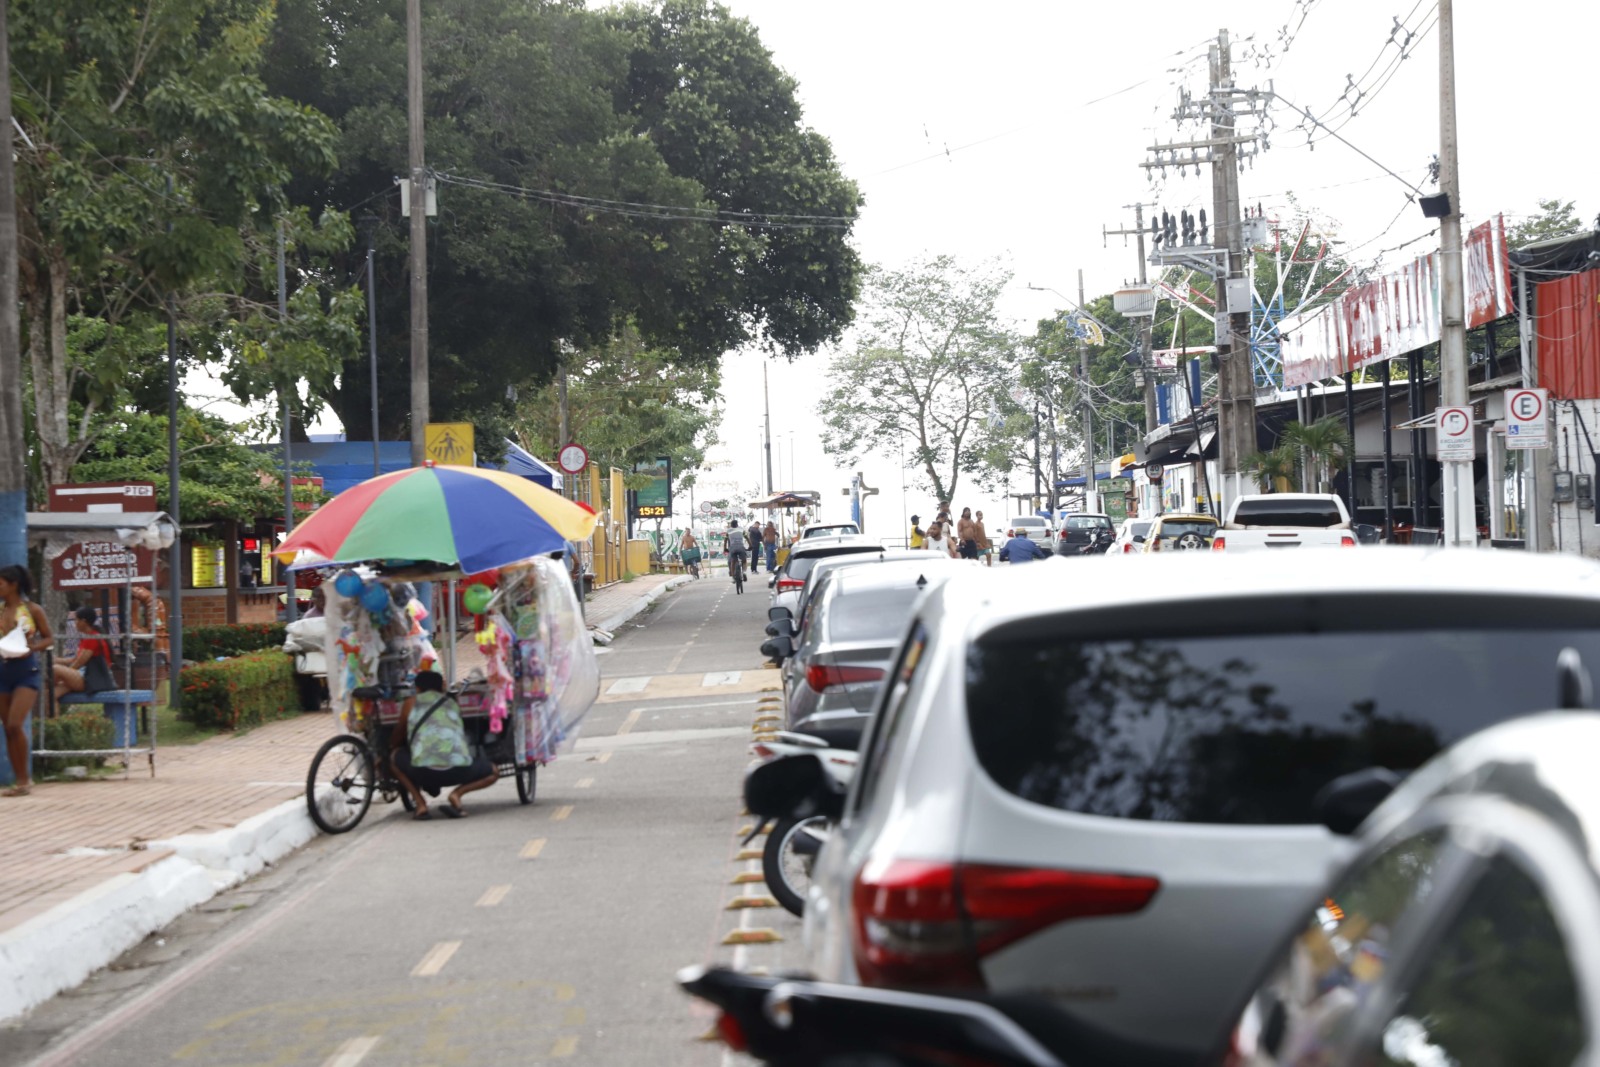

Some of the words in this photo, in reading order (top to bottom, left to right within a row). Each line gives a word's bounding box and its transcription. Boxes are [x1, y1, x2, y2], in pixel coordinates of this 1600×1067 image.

[1520, 397, 1531, 415] E
[639, 507, 665, 516] 15:21
[73, 567, 89, 579] do
